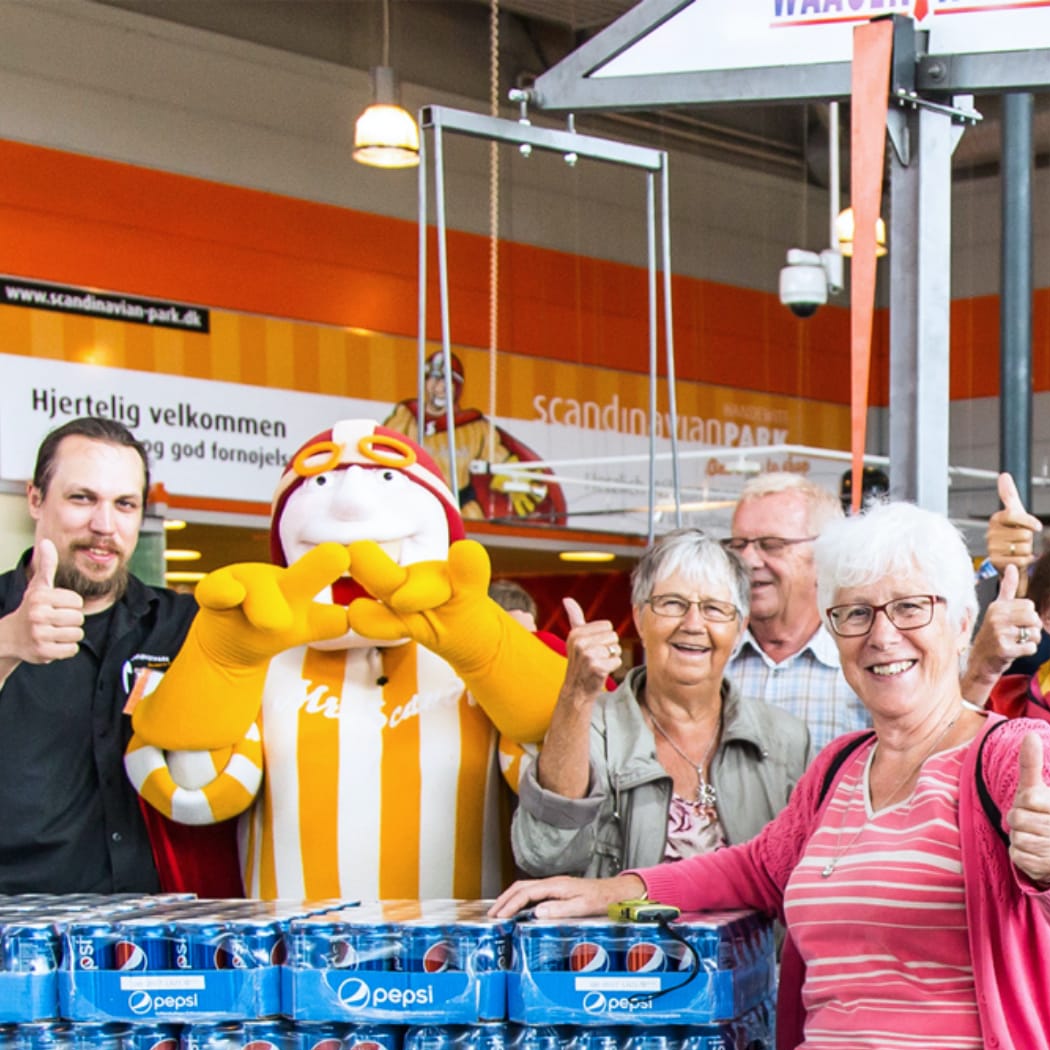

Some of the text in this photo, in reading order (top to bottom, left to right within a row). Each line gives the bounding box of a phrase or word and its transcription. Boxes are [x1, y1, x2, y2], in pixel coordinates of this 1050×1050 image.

[5, 286, 202, 327] www.scandinavian-park.dk
[31, 387, 287, 439] Hjertelig velkommen
[171, 440, 205, 462] god
[154, 994, 198, 1009] pepsi
[373, 986, 433, 1008] pepsi
